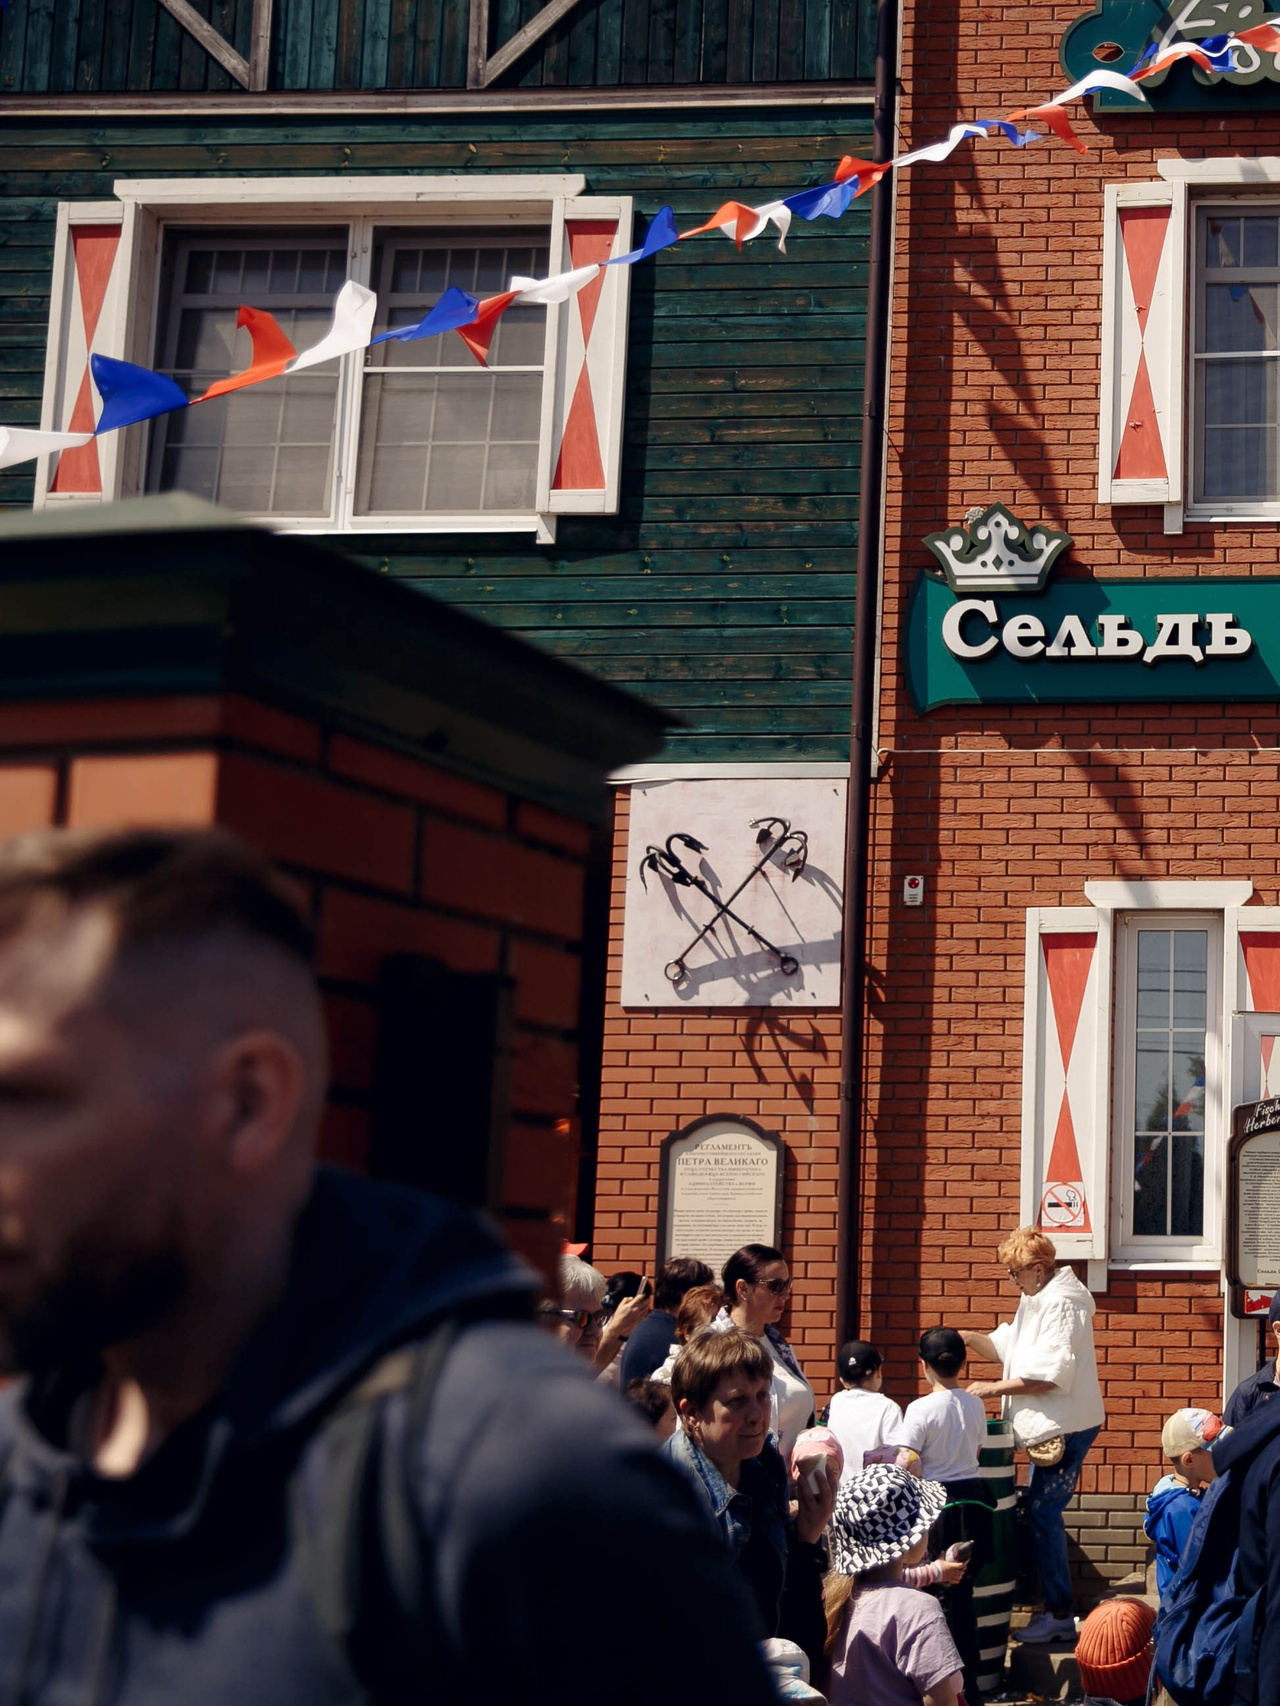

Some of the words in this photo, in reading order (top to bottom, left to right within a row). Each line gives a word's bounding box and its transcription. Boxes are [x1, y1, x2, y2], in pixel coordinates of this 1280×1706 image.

[941, 598, 1254, 666] Сельдь
[677, 1158, 711, 1166] ПЕТРА
[714, 1158, 768, 1166] ВЕЛИКАГО
